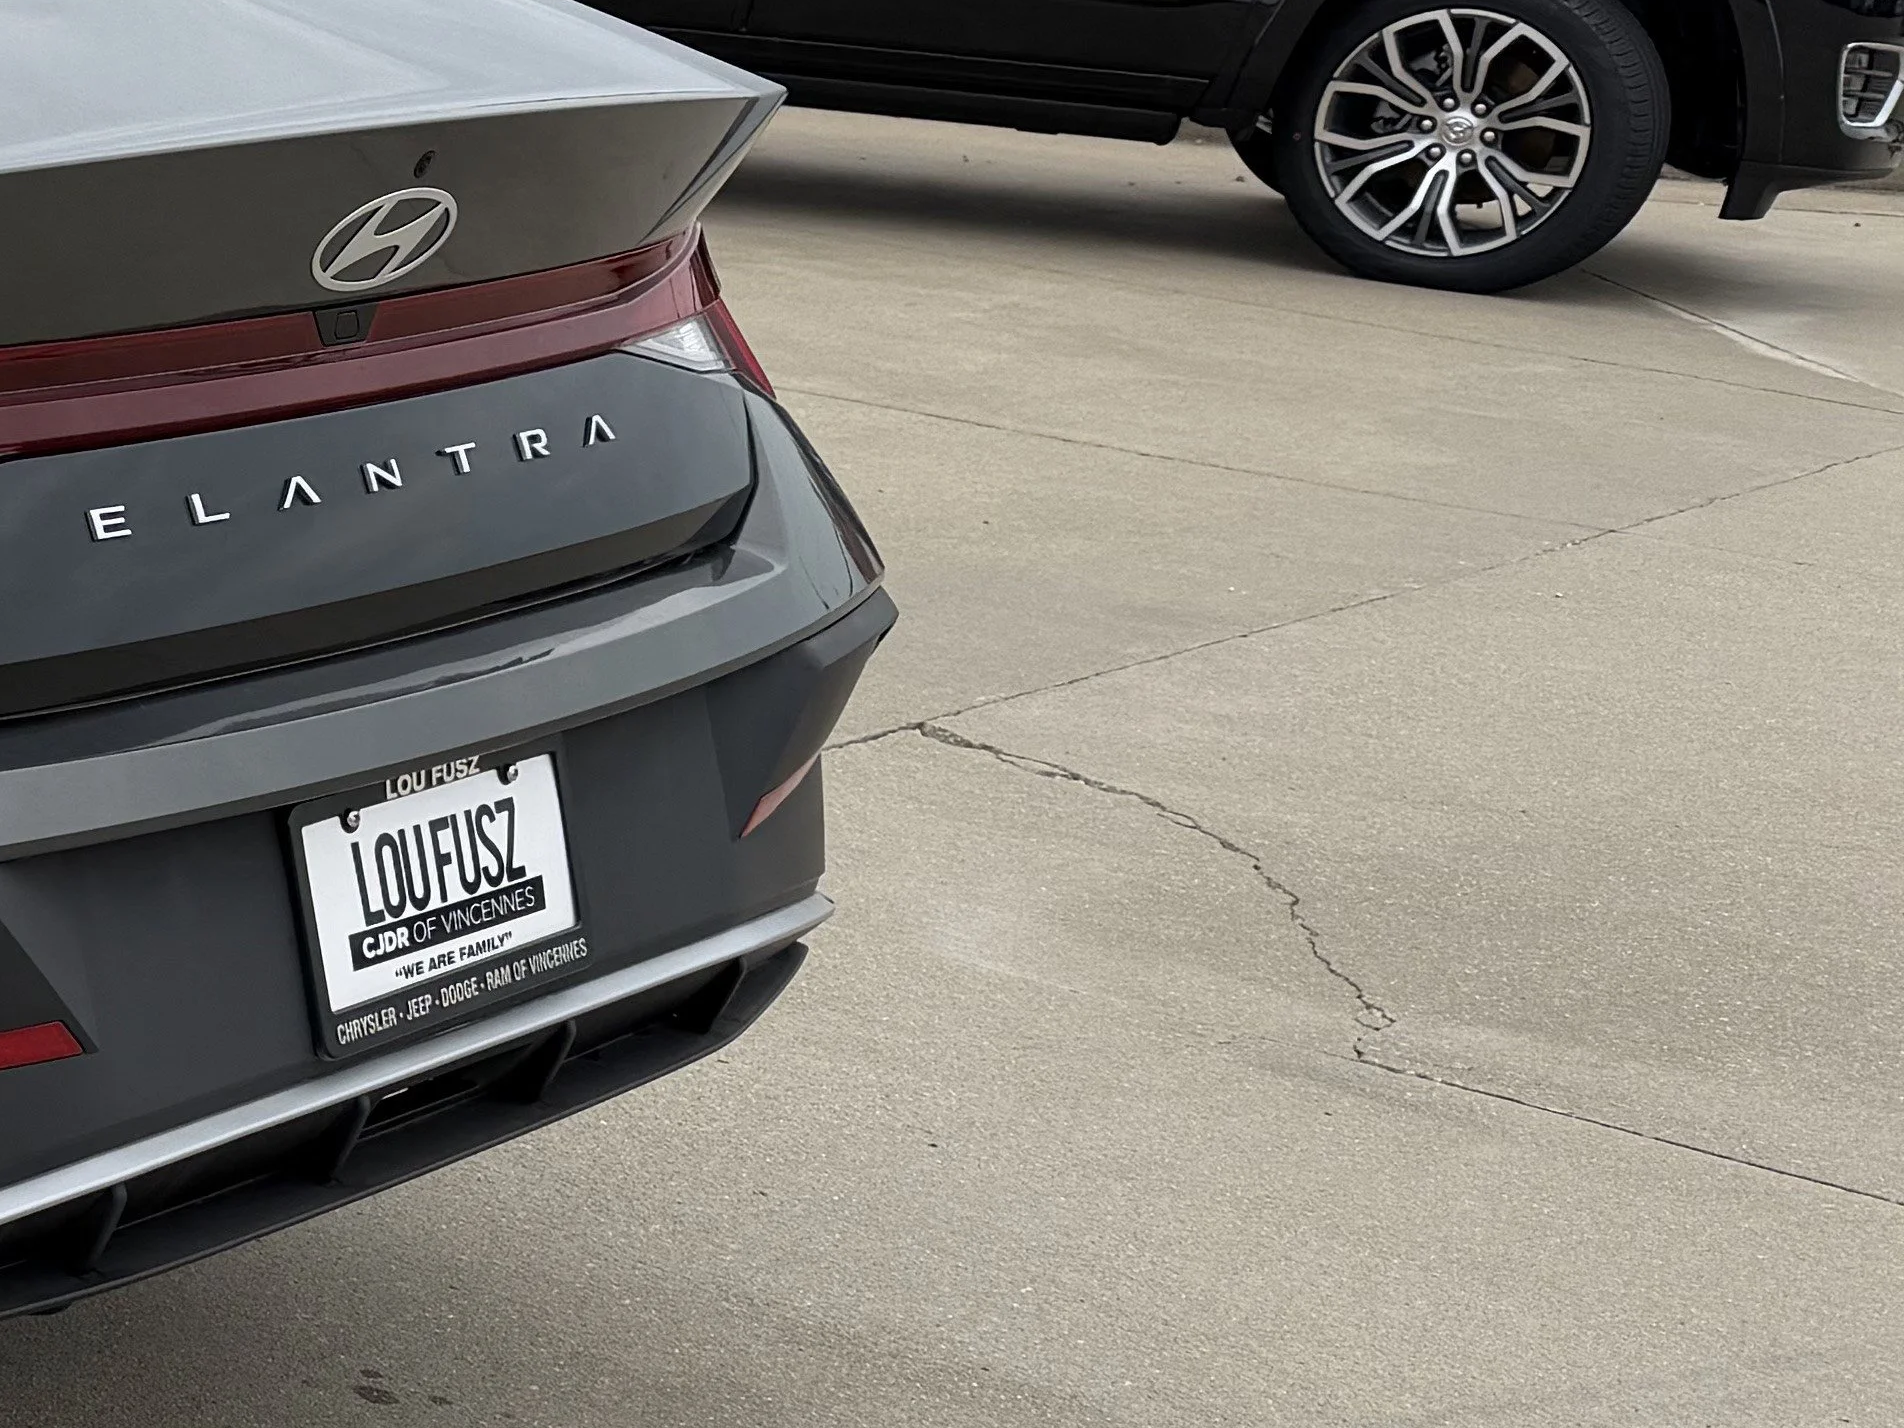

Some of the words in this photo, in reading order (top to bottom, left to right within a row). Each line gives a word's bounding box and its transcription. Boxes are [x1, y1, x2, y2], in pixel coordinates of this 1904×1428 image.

[87, 413, 617, 540] ELANTRA
[385, 772, 426, 800] LOU
[432, 755, 480, 786] FUSZ
[362, 922, 410, 960] CJDR
[412, 916, 437, 943] OF
[440, 885, 536, 935] VINCENNES
[428, 949, 457, 970] ARE
[336, 1006, 398, 1046] CHRYSLER
[406, 994, 432, 1021] JEEP
[440, 976, 480, 1008] DODGE
[485, 969, 512, 992] RAM
[514, 960, 529, 982] OF
[528, 937, 589, 976] VINCENNES
